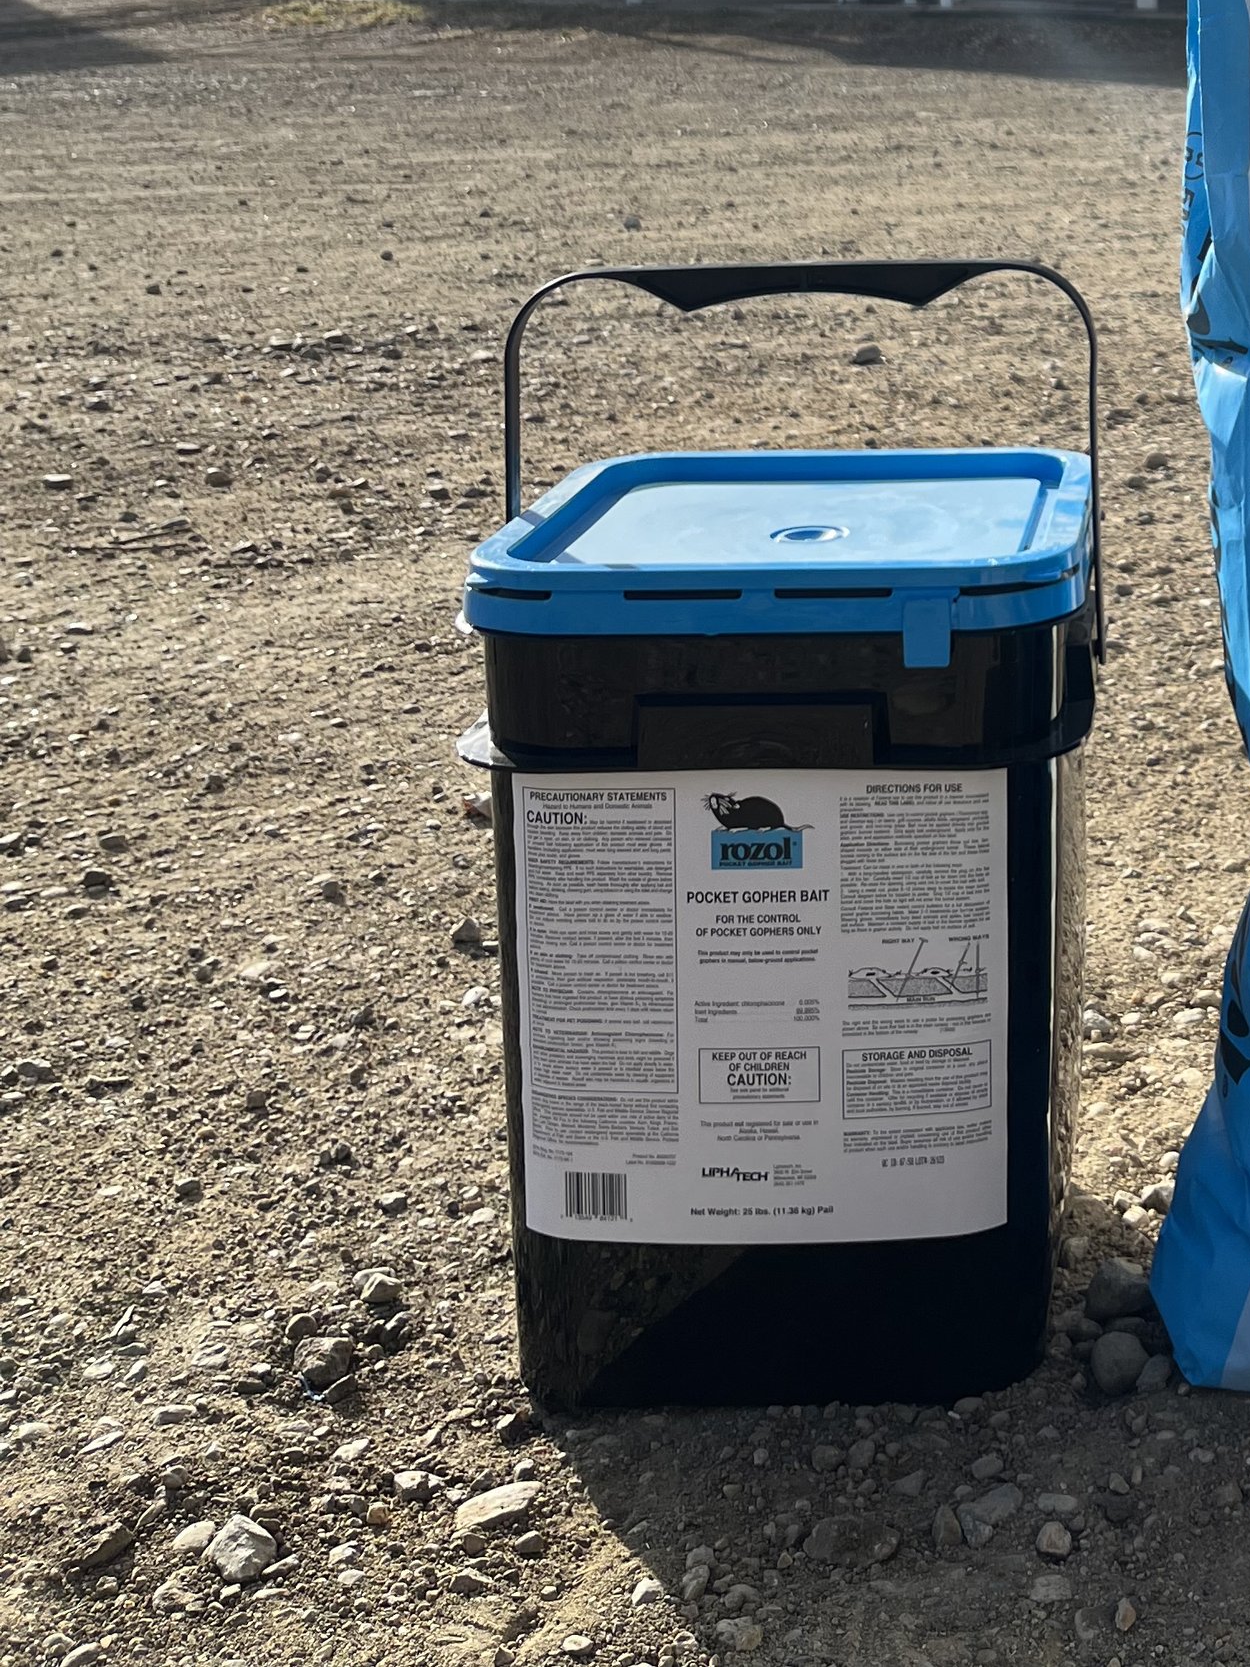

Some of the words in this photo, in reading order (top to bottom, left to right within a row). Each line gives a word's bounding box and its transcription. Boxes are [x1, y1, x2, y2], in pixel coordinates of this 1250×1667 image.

[865, 783, 921, 794] DIRECTIONS
[922, 782, 942, 793] FOR
[944, 782, 963, 793] USE
[529, 791, 604, 801] PRECAUTIONARY
[606, 791, 667, 801] STATEMENTS
[527, 810, 588, 825] CAUTION:
[720, 837, 791, 860] rozol
[686, 890, 738, 904] POCKET
[741, 890, 796, 903] GOPHER
[799, 889, 829, 902] BAIT
[715, 914, 735, 924] FOR
[737, 914, 755, 924] THE
[756, 913, 801, 924] CONTROL
[695, 927, 708, 937] OF
[710, 927, 747, 937] POCKET
[749, 926, 794, 937] GOPHERS
[796, 926, 821, 936] ONLY
[711, 1051, 736, 1061] KEEP
[738, 1051, 757, 1061] OUT
[759, 1051, 772, 1061] OF
[774, 1050, 807, 1060] REACH
[861, 1050, 905, 1062] STORAGE
[907, 1049, 927, 1059] AND
[928, 1046, 974, 1058] DISPOSAL
[728, 1062, 741, 1072] OF
[743, 1061, 790, 1072] CHILDREN
[727, 1073, 792, 1086] CAUTION:
[702, 1167, 769, 1182] LIPHATECH
[690, 1207, 705, 1216] Net
[707, 1207, 740, 1217] Weight:
[742, 1207, 753, 1216] 25
[754, 1207, 770, 1215] lbs.
[800, 1206, 815, 1216] kg)
[816, 1205, 834, 1214] Pail
